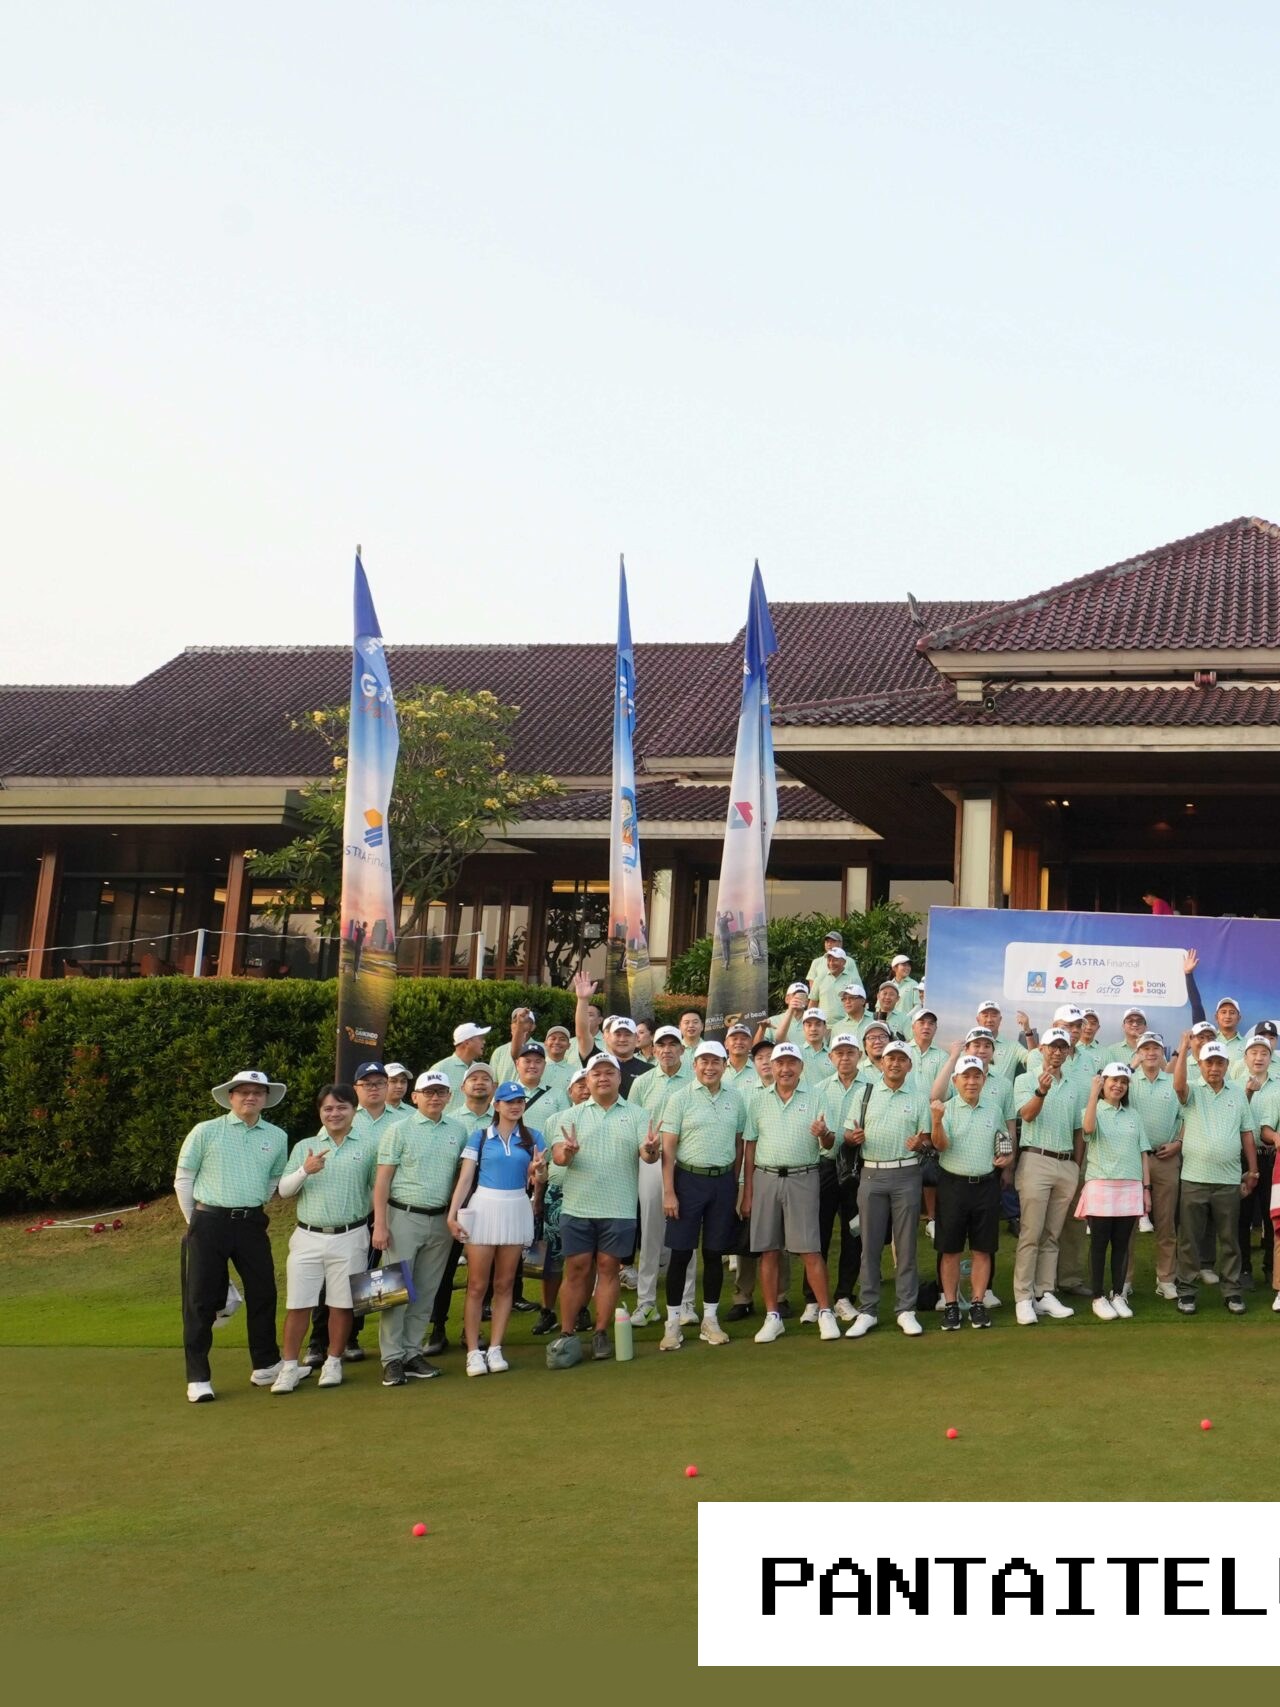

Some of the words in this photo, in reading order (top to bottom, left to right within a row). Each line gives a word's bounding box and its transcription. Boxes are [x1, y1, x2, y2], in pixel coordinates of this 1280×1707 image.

[1075, 958, 1106, 967] ASTRA
[1106, 959, 1140, 968] Financial
[1071, 979, 1090, 990] taf
[1147, 980, 1166, 988] bank
[1096, 985, 1121, 994] astra
